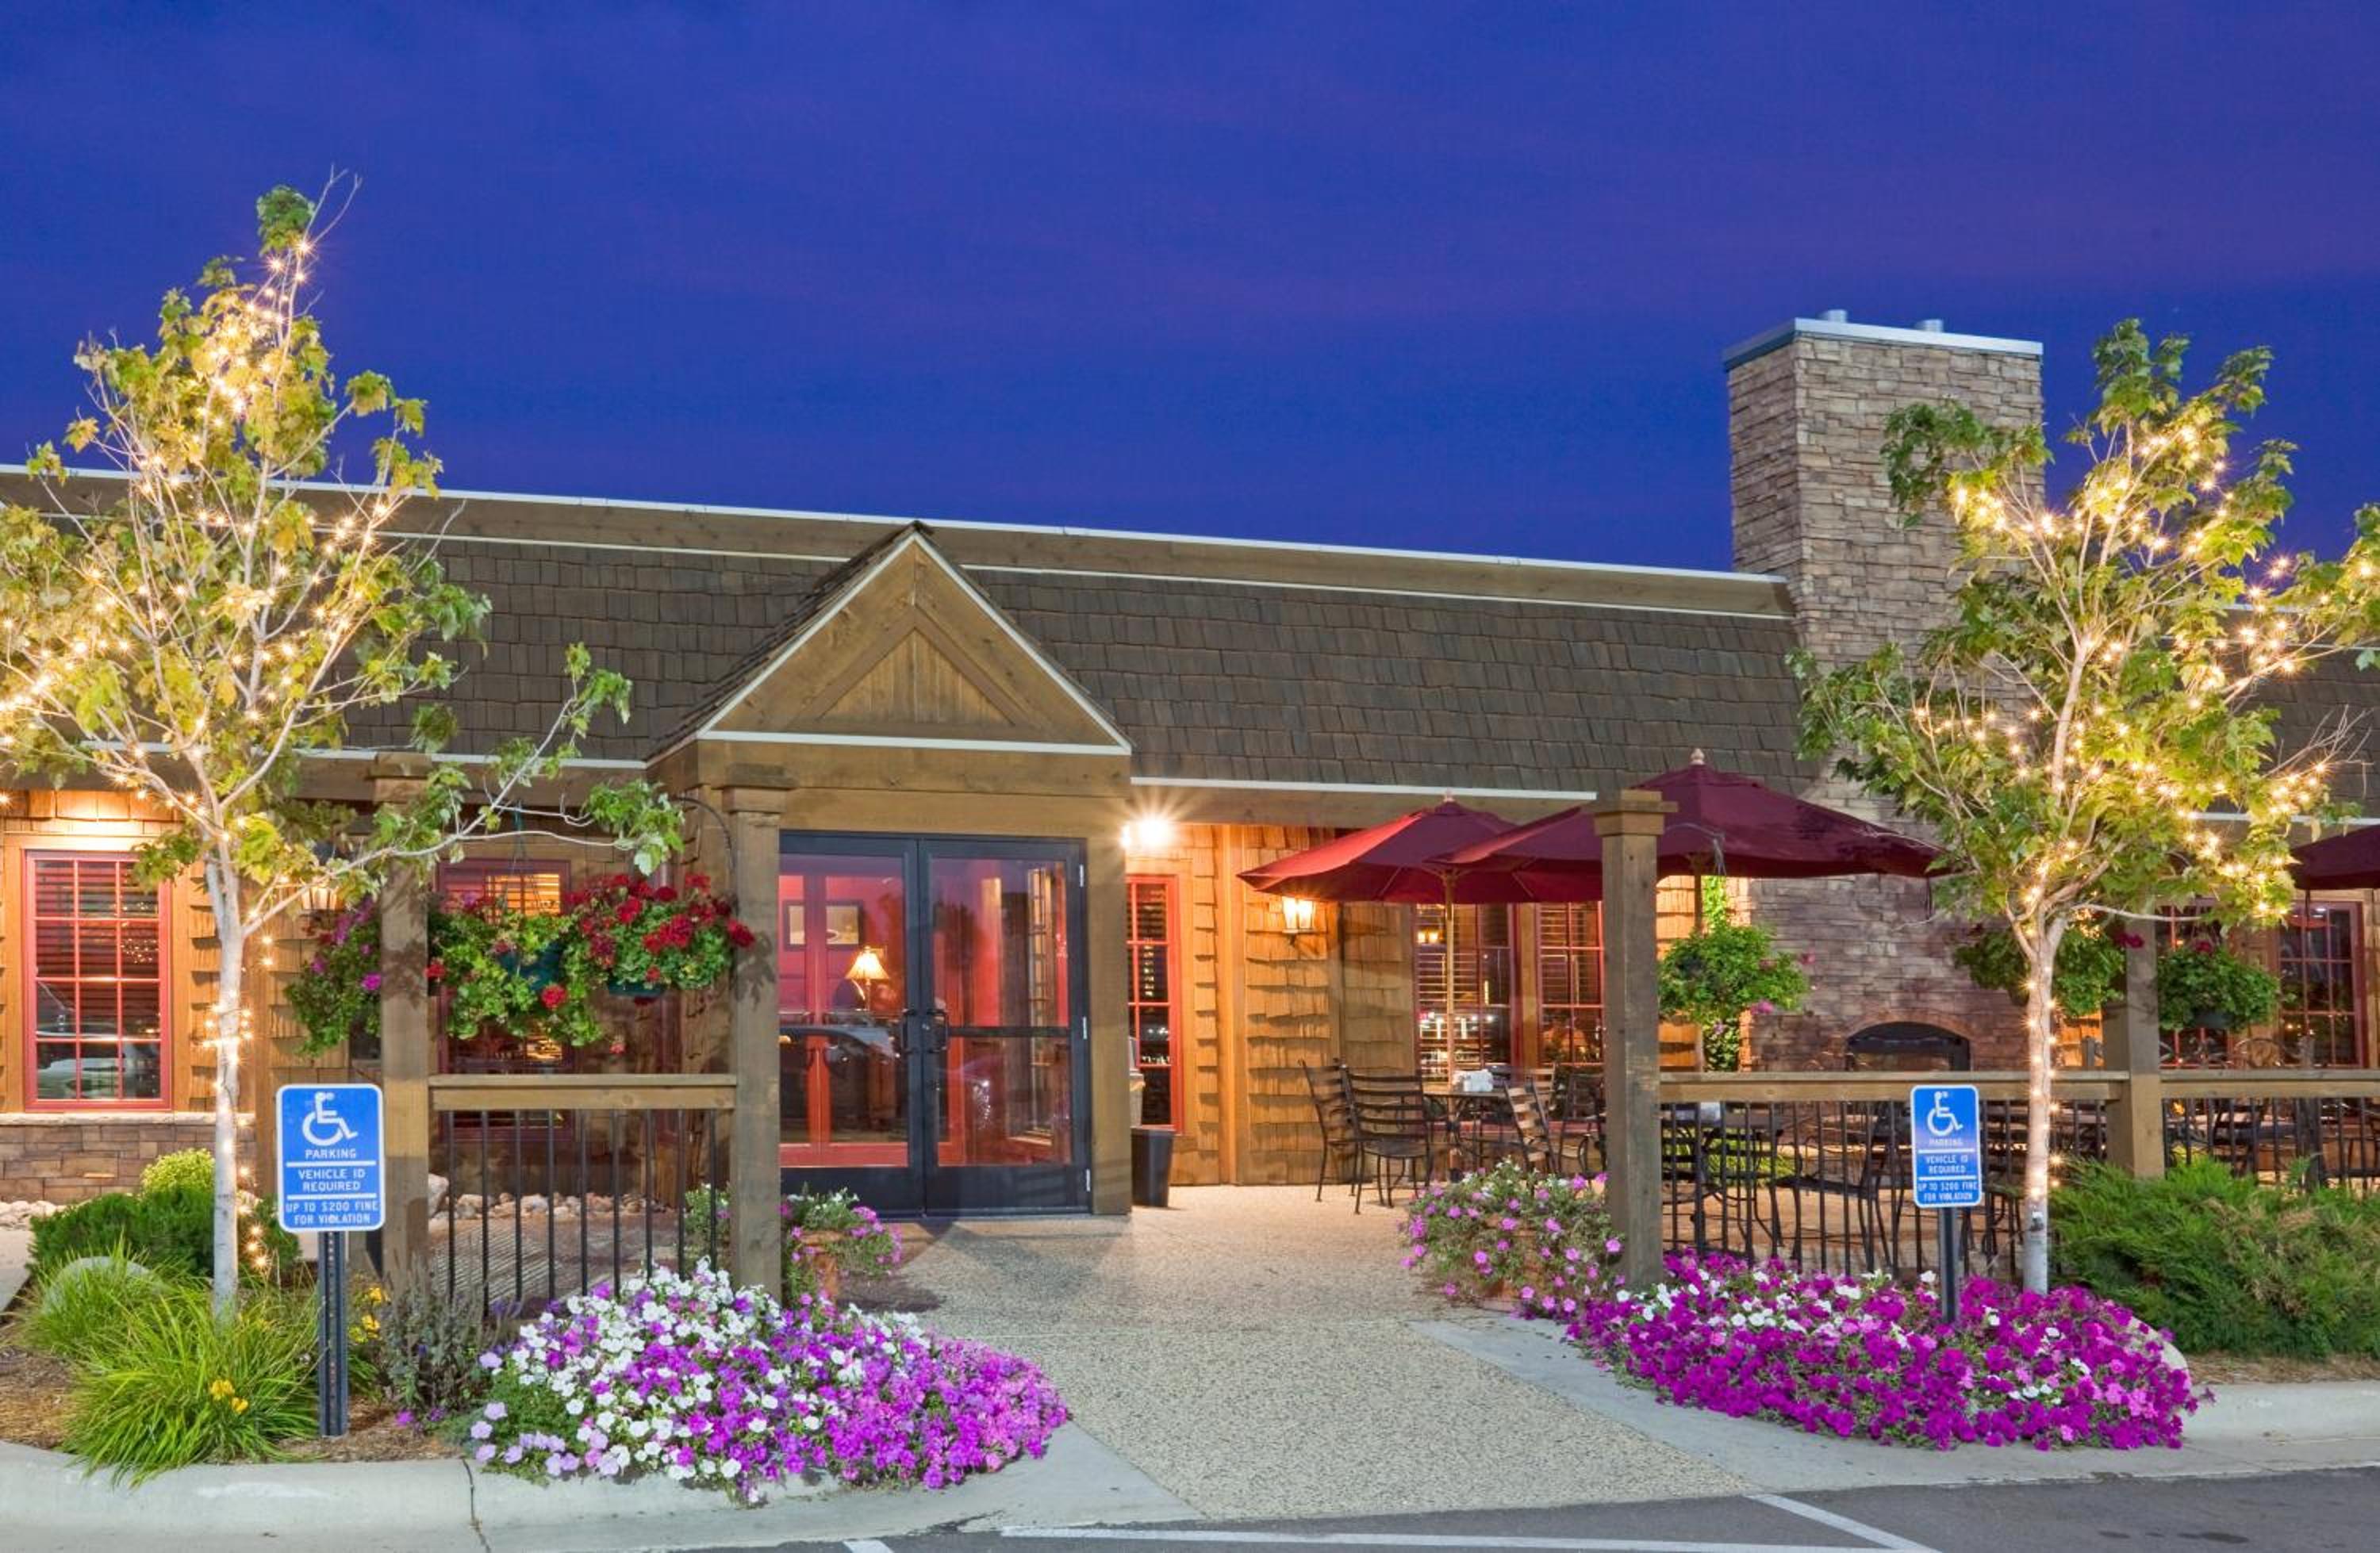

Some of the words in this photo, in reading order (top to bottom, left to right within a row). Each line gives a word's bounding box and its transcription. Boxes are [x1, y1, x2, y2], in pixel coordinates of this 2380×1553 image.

[305, 1148, 356, 1159] PARKING
[1925, 1155, 1956, 1164] VEHICLE
[1960, 1154, 1968, 1163] ID
[298, 1169, 347, 1179] VEHICLE
[354, 1168, 366, 1178] ID
[1929, 1165, 1966, 1174] REQUIRED
[302, 1182, 360, 1192] REQUIRED
[1918, 1183, 1927, 1191] UP
[1929, 1183, 1937, 1191] TO
[1963, 1181, 1978, 1190] FINE
[1924, 1193, 1937, 1202] FOR
[1939, 1192, 1973, 1201] VIOLATION
[286, 1203, 299, 1213] UP
[304, 1202, 316, 1213] TO
[321, 1202, 350, 1212] $200
[355, 1201, 378, 1211] FINE
[294, 1216, 313, 1225] FOR
[319, 1214, 370, 1225] VIOLATION
